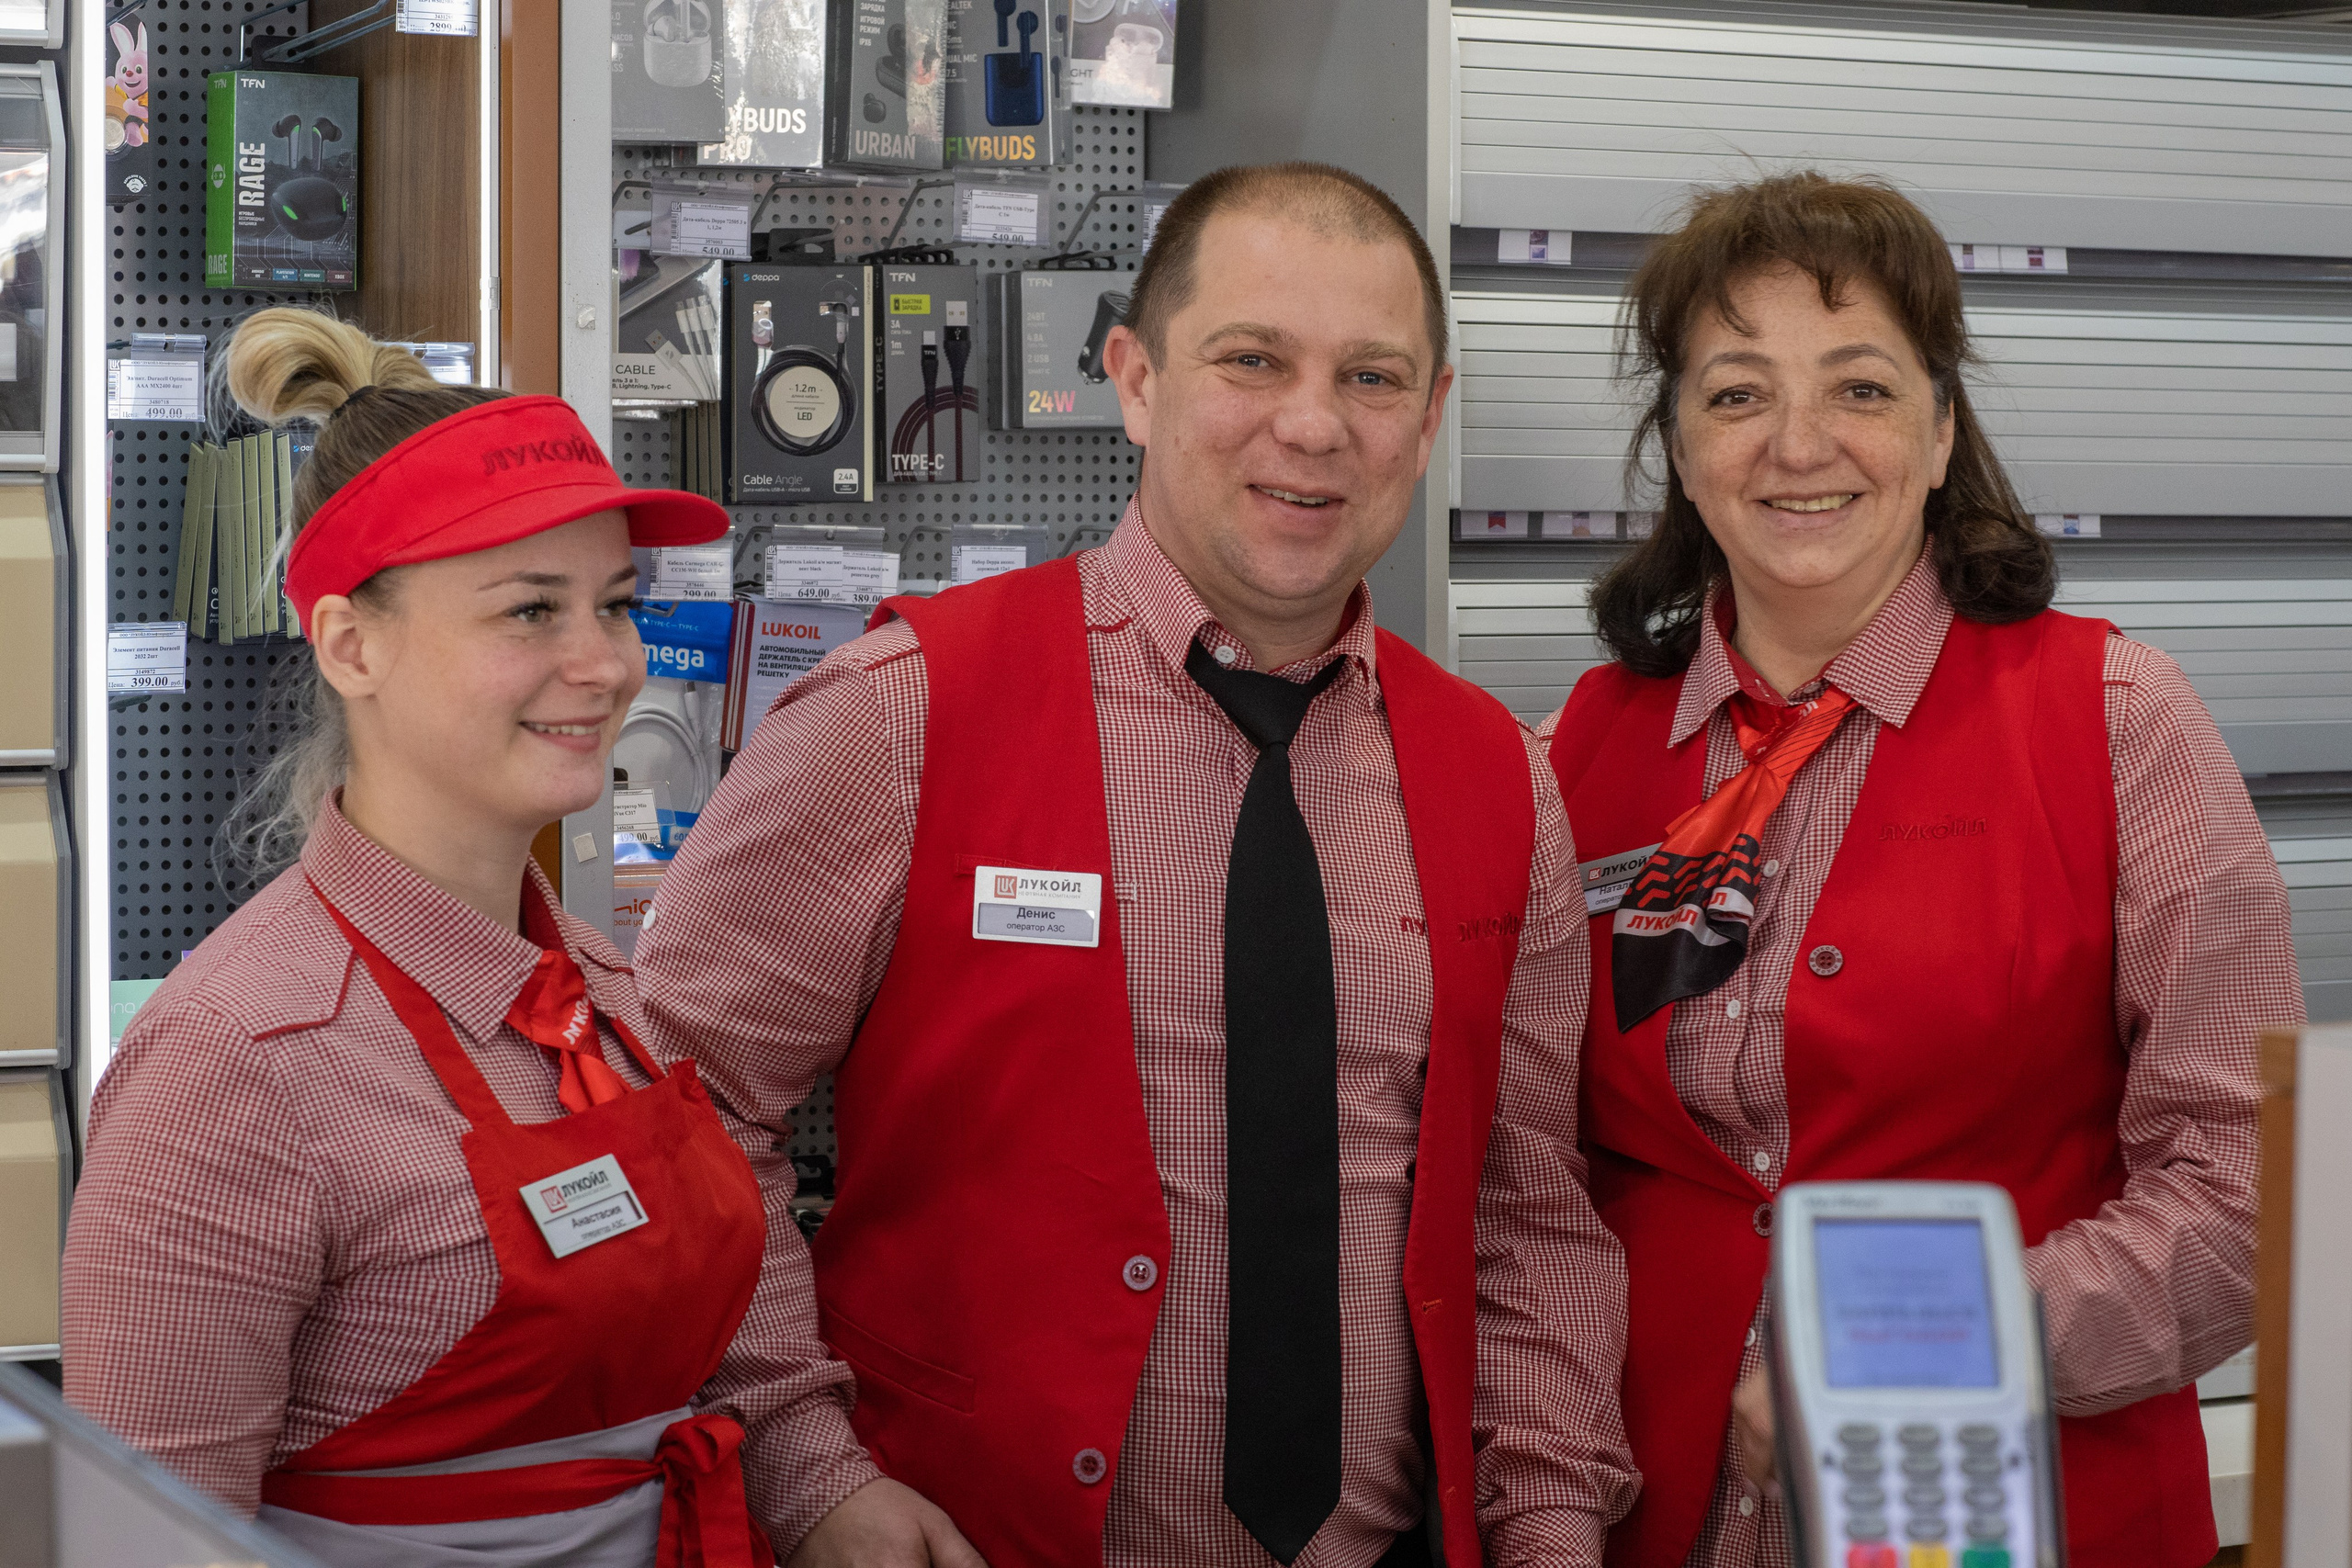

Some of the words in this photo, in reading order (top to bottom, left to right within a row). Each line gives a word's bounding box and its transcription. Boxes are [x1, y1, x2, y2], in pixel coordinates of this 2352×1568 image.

[860, 3, 885, 12] ЗАРЯДКА
[860, 16, 885, 25] ИГРОВОЙ
[860, 26, 880, 34] РЕЖИМ
[214, 78, 227, 89] TFN
[241, 78, 266, 89] TFN
[725, 107, 807, 134] YBUDS
[855, 130, 917, 160] URBAN
[946, 135, 1035, 162] FLYBUDS
[239, 142, 266, 207] RAGE
[992, 233, 1023, 242] 54900
[702, 246, 735, 255] 54900
[208, 254, 228, 275] RAGE
[752, 274, 780, 282] deppa
[889, 272, 916, 282] TFN
[1026, 277, 1053, 288] TFN
[615, 365, 655, 375] CABLE
[1028, 389, 1076, 413] 24W
[146, 407, 183, 419] 499.00
[797, 412, 813, 421] LED
[481, 434, 607, 477] ЛУКОЙЛ
[892, 454, 944, 470] TYPE-C
[743, 474, 773, 485] Cable
[775, 474, 803, 487] Angle
[838, 472, 854, 480] 2.4A
[797, 588, 830, 598] 649.00
[852, 593, 884, 604] 389.00
[761, 622, 821, 640] LUKOIL
[759, 645, 826, 656] АВТОМОБИЛЬНЫЙ
[642, 643, 705, 671] mega
[758, 653, 800, 661] ДЕРЖАТЕЛЬ
[770, 663, 814, 671] ВЕНТИЛЯЦИ
[130, 676, 168, 688] 399.00
[1878, 813, 1987, 841] ЛУКОЙЛ
[618, 831, 648, 842] 499.00
[1601, 854, 1650, 877] ЛУКОЙ
[1018, 878, 1081, 894] ЛУКОЙЛ
[1599, 882, 1630, 895] Натал
[1595, 895, 1623, 905] операто
[1016, 907, 1056, 919] Денис
[1627, 908, 1699, 931] ЛУКОЙЛ
[1007, 922, 1046, 933] оператор
[1046, 924, 1066, 932] АЗС
[561, 1170, 609, 1198] ЛУКОЙЛ
[571, 1205, 623, 1228] Анастасия
